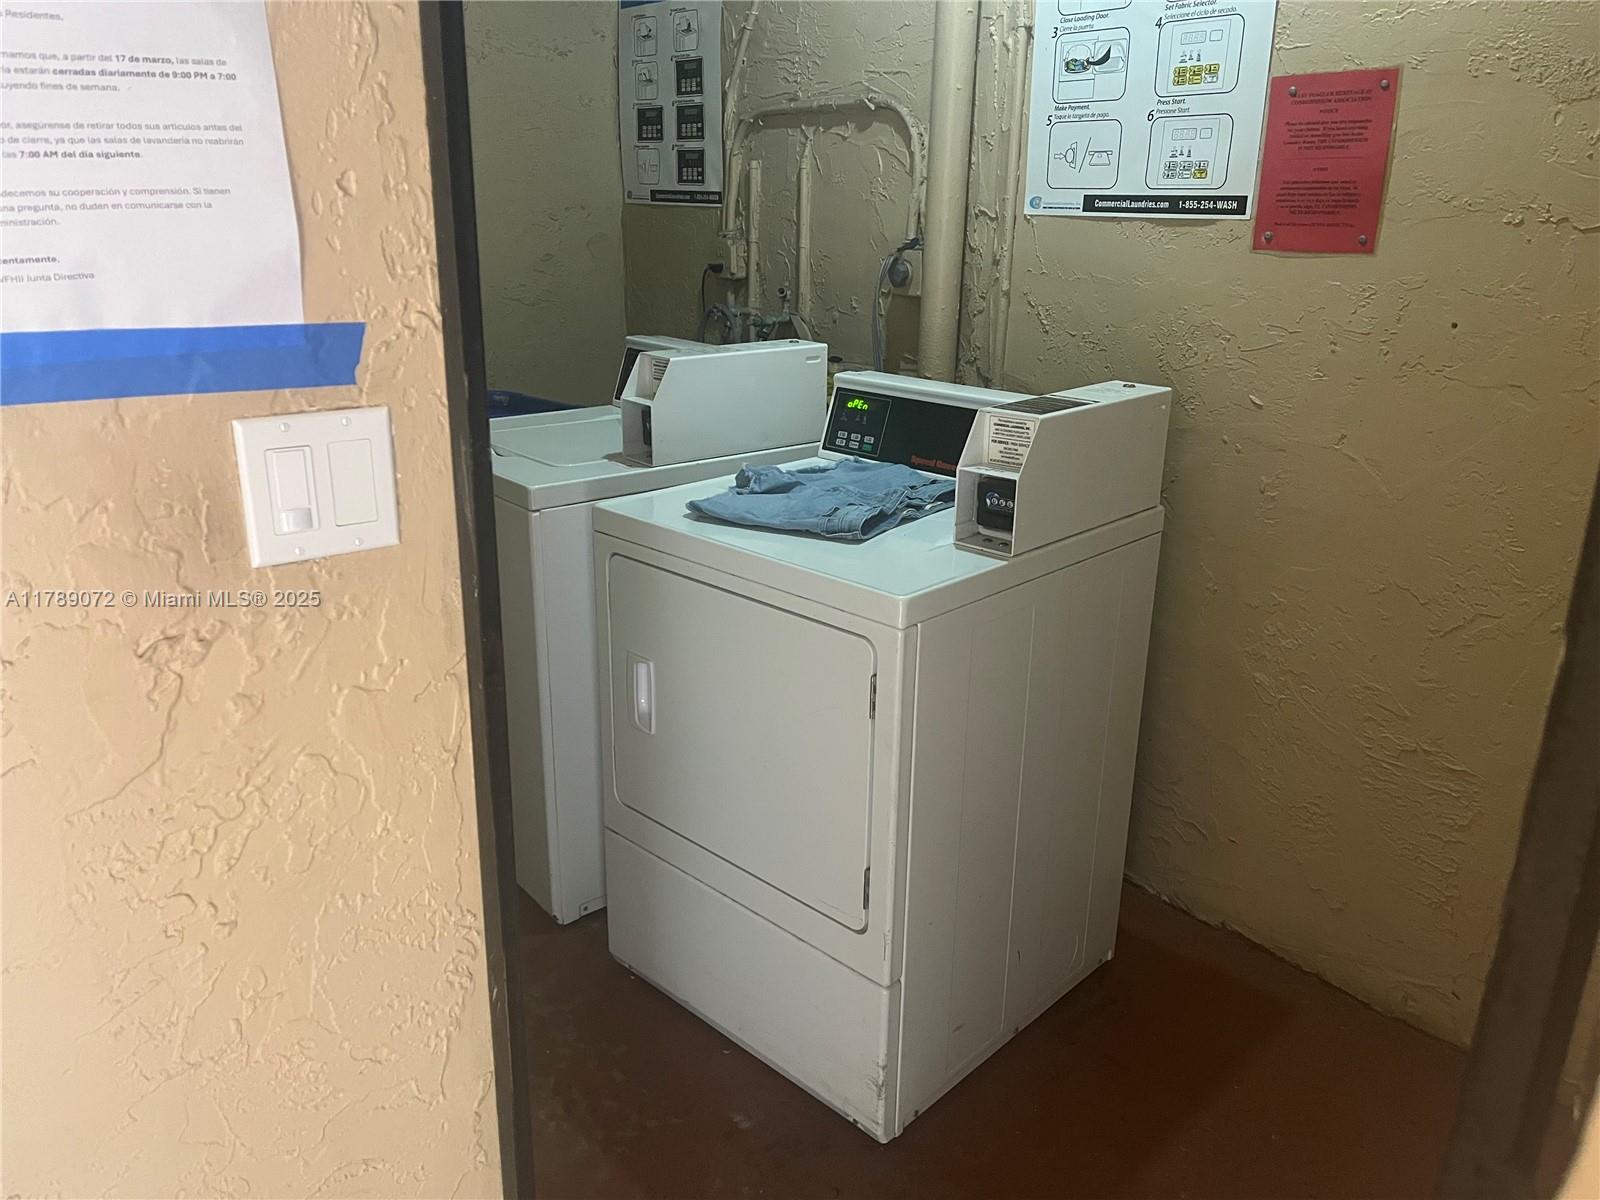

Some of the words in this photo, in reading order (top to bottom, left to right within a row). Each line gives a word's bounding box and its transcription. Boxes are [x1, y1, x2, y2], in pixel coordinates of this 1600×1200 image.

[1165, 3, 1174, 11] Set
[1175, 2, 1191, 10] Fabric
[1060, 16, 1074, 24] Close
[1074, 14, 1095, 23] Loading
[1155, 16, 1163, 29] 4
[1051, 26, 1059, 38] 3
[38, 52, 60, 62] que,
[70, 53, 96, 63] partir
[98, 54, 113, 62] del
[115, 54, 126, 62] 17
[127, 55, 140, 63] de
[142, 57, 174, 66] marzo,
[176, 57, 190, 65] las
[191, 57, 215, 66] salas
[216, 58, 228, 66] de
[52, 67, 97, 76] cerradas
[98, 68, 157, 78] diariamente
[158, 70, 170, 78] de
[172, 71, 192, 79] 9:00
[193, 71, 208, 80] PM
[218, 73, 237, 81] 7:00
[40, 81, 64, 91] fines
[65, 82, 78, 91] de
[80, 84, 121, 92] semana.
[1156, 98, 1171, 106] Press
[1171, 97, 1187, 105] Start.
[1147, 109, 1155, 122] 6
[1155, 107, 1177, 115] Presione
[1045, 114, 1053, 127] 5
[72, 121, 85, 130] de
[86, 121, 114, 130] retirar
[116, 121, 142, 130] todos
[203, 123, 227, 131] antes
[228, 123, 243, 132] del
[7, 135, 20, 144] de
[22, 136, 53, 145] cierre,
[54, 138, 65, 146] ya
[67, 137, 85, 146] que
[87, 136, 102, 144] las
[103, 136, 128, 145] salas
[129, 136, 142, 145] de
[18, 150, 41, 159] 7:00
[42, 150, 59, 159] AM
[60, 150, 77, 159] del
[96, 150, 144, 161] siguiente.
[62, 187, 121, 199] cooperación
[121, 189, 128, 197] y
[192, 187, 202, 195] Si
[203, 187, 231, 196] tienen
[16, 204, 63, 213] pregunta,
[79, 202, 109, 211] duden
[110, 202, 123, 210] en
[124, 202, 184, 210] comunicarse
[1094, 198, 1170, 210] CommercialLaundries.com
[1178, 199, 1238, 211] 1-855-254-WASH
[26, 274, 52, 283] Junta
[53, 272, 95, 282] Directiva
